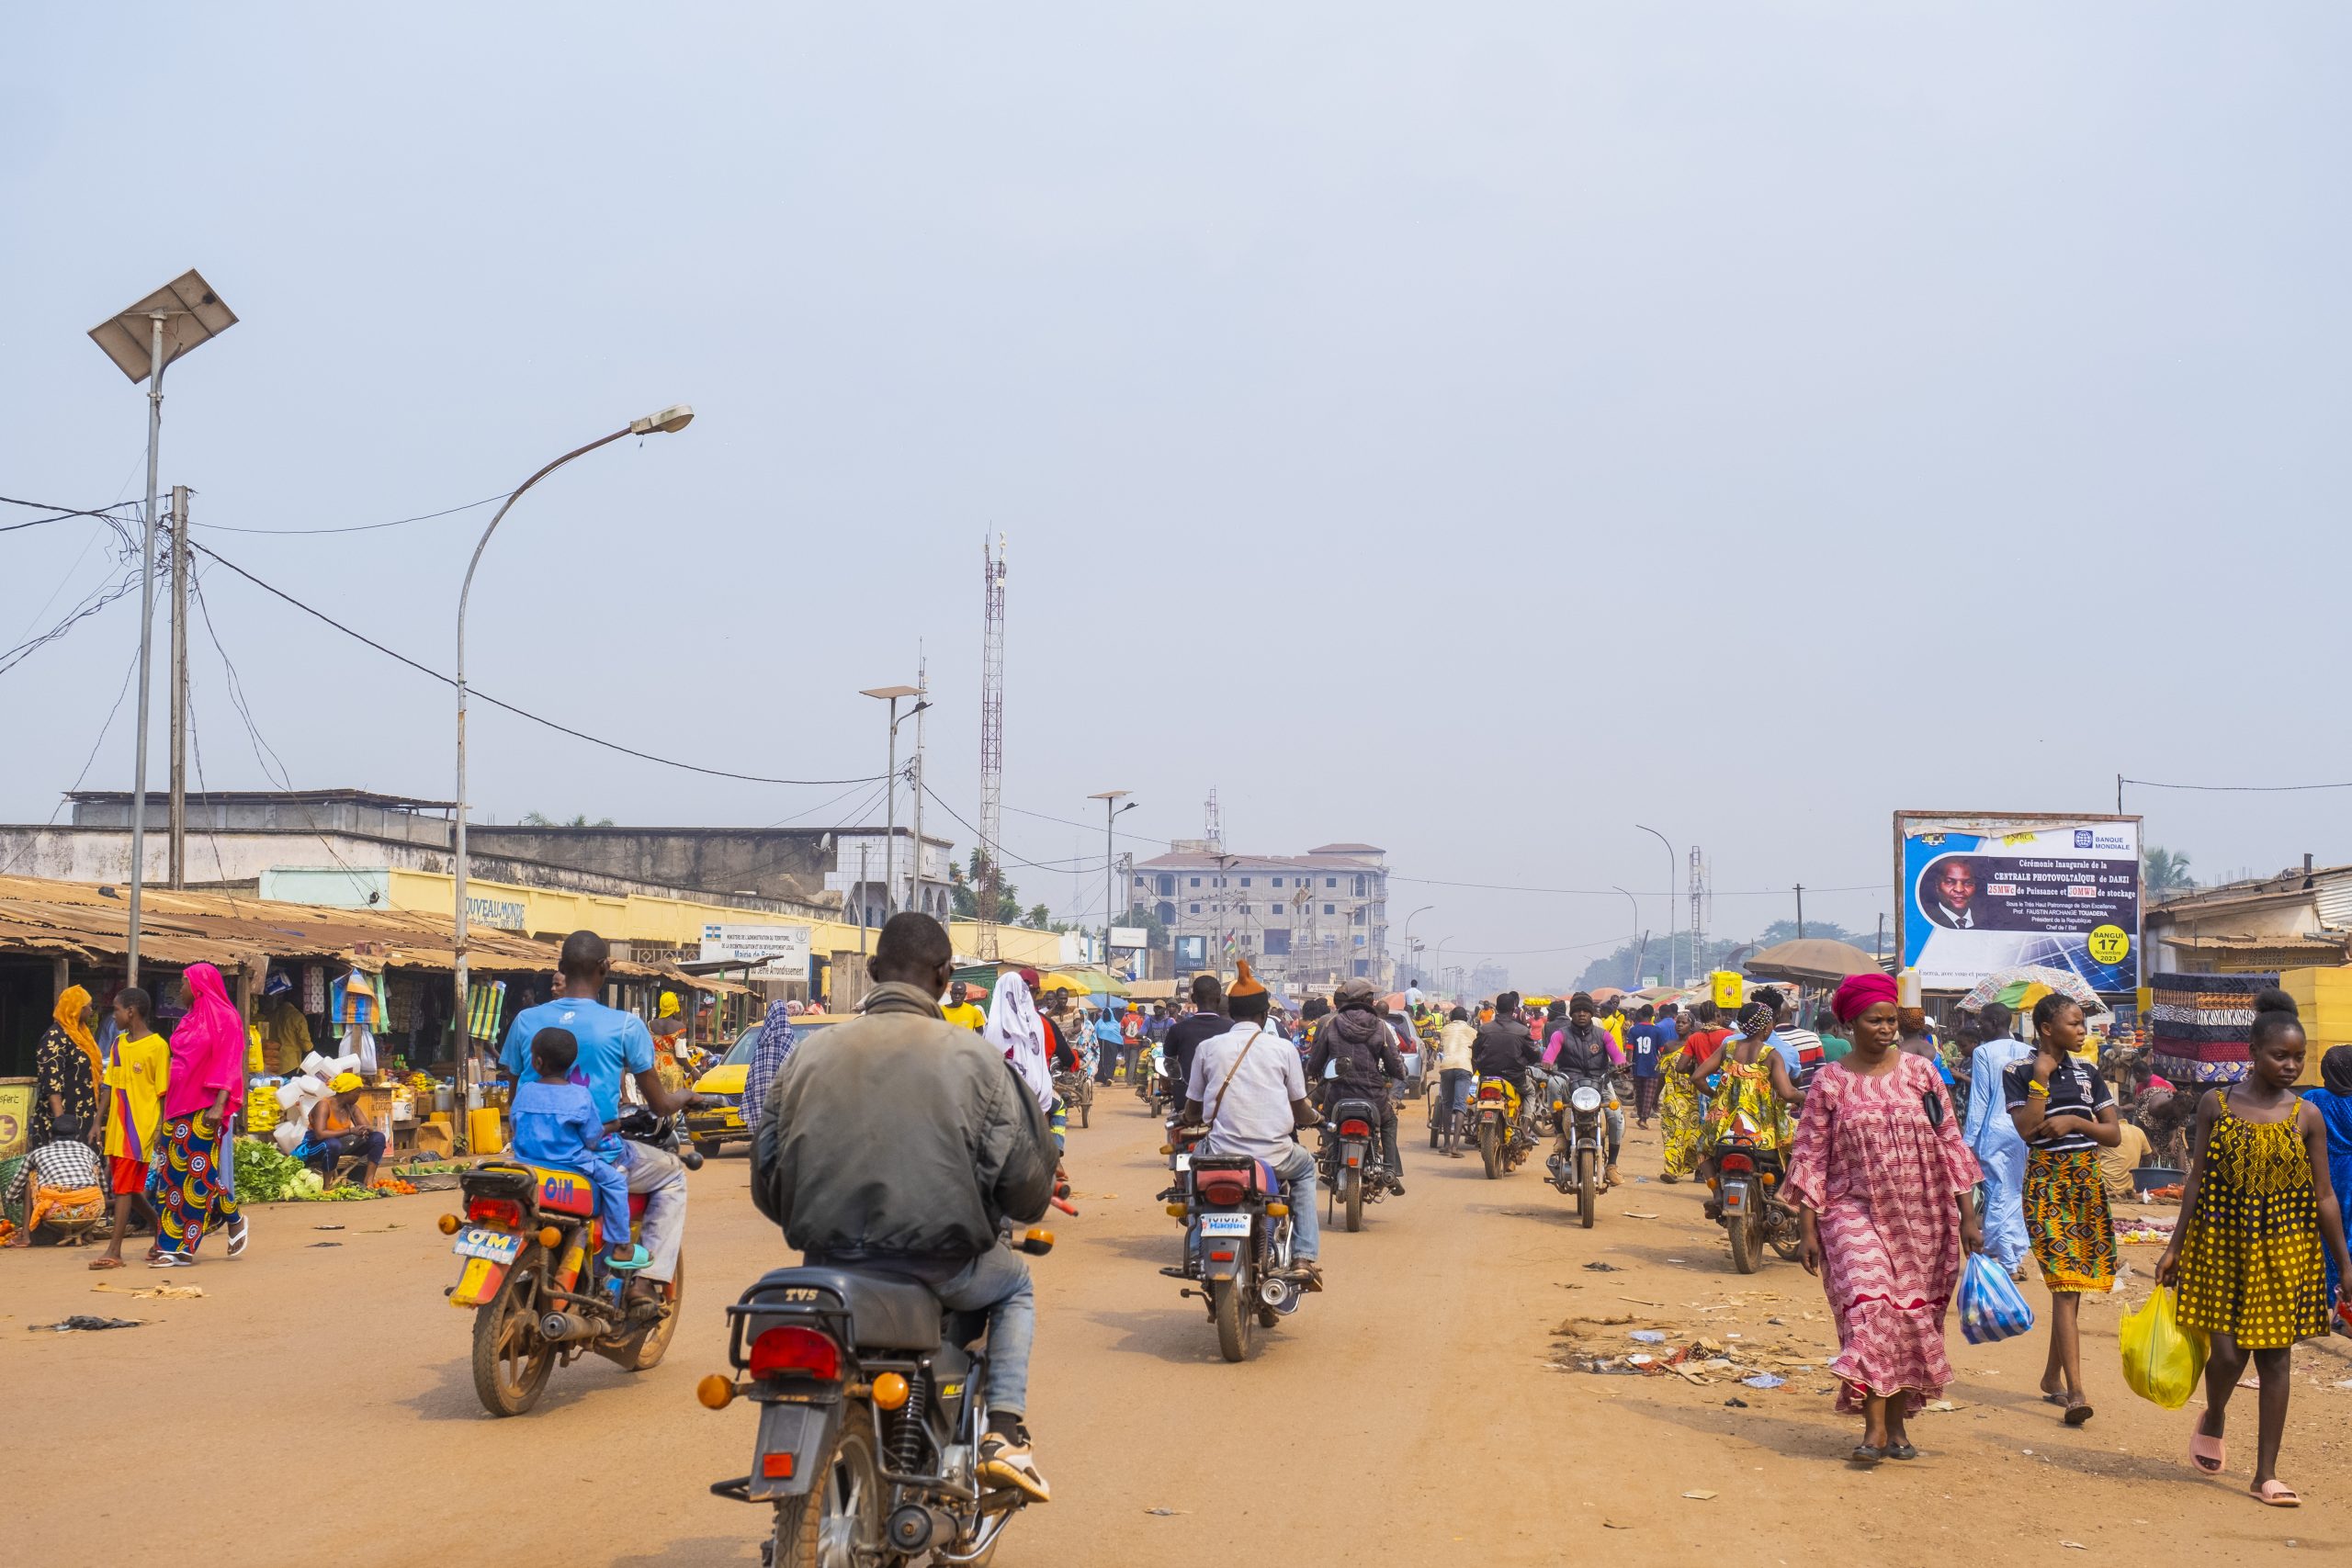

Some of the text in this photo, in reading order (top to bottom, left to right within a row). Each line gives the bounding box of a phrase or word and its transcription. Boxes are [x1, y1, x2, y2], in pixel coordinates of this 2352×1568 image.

[2018, 859, 2054, 868] Cérémonie
[2054, 860, 2089, 870] Inaugurale
[2100, 862, 2107, 870] la
[1994, 872, 2130, 884] CENTRALE PHOTOVOLTAÏQUE de DANZI
[1987, 885, 2015, 895] 25MWc
[2016, 886, 2025, 895] de
[2026, 886, 2059, 896] Puissance
[2097, 888, 2106, 897] de
[2107, 889, 2135, 898] stockage
[2098, 939, 2119, 951] 17
[1636, 1036, 1651, 1054] 19
[786, 1288, 820, 1302] TVS
